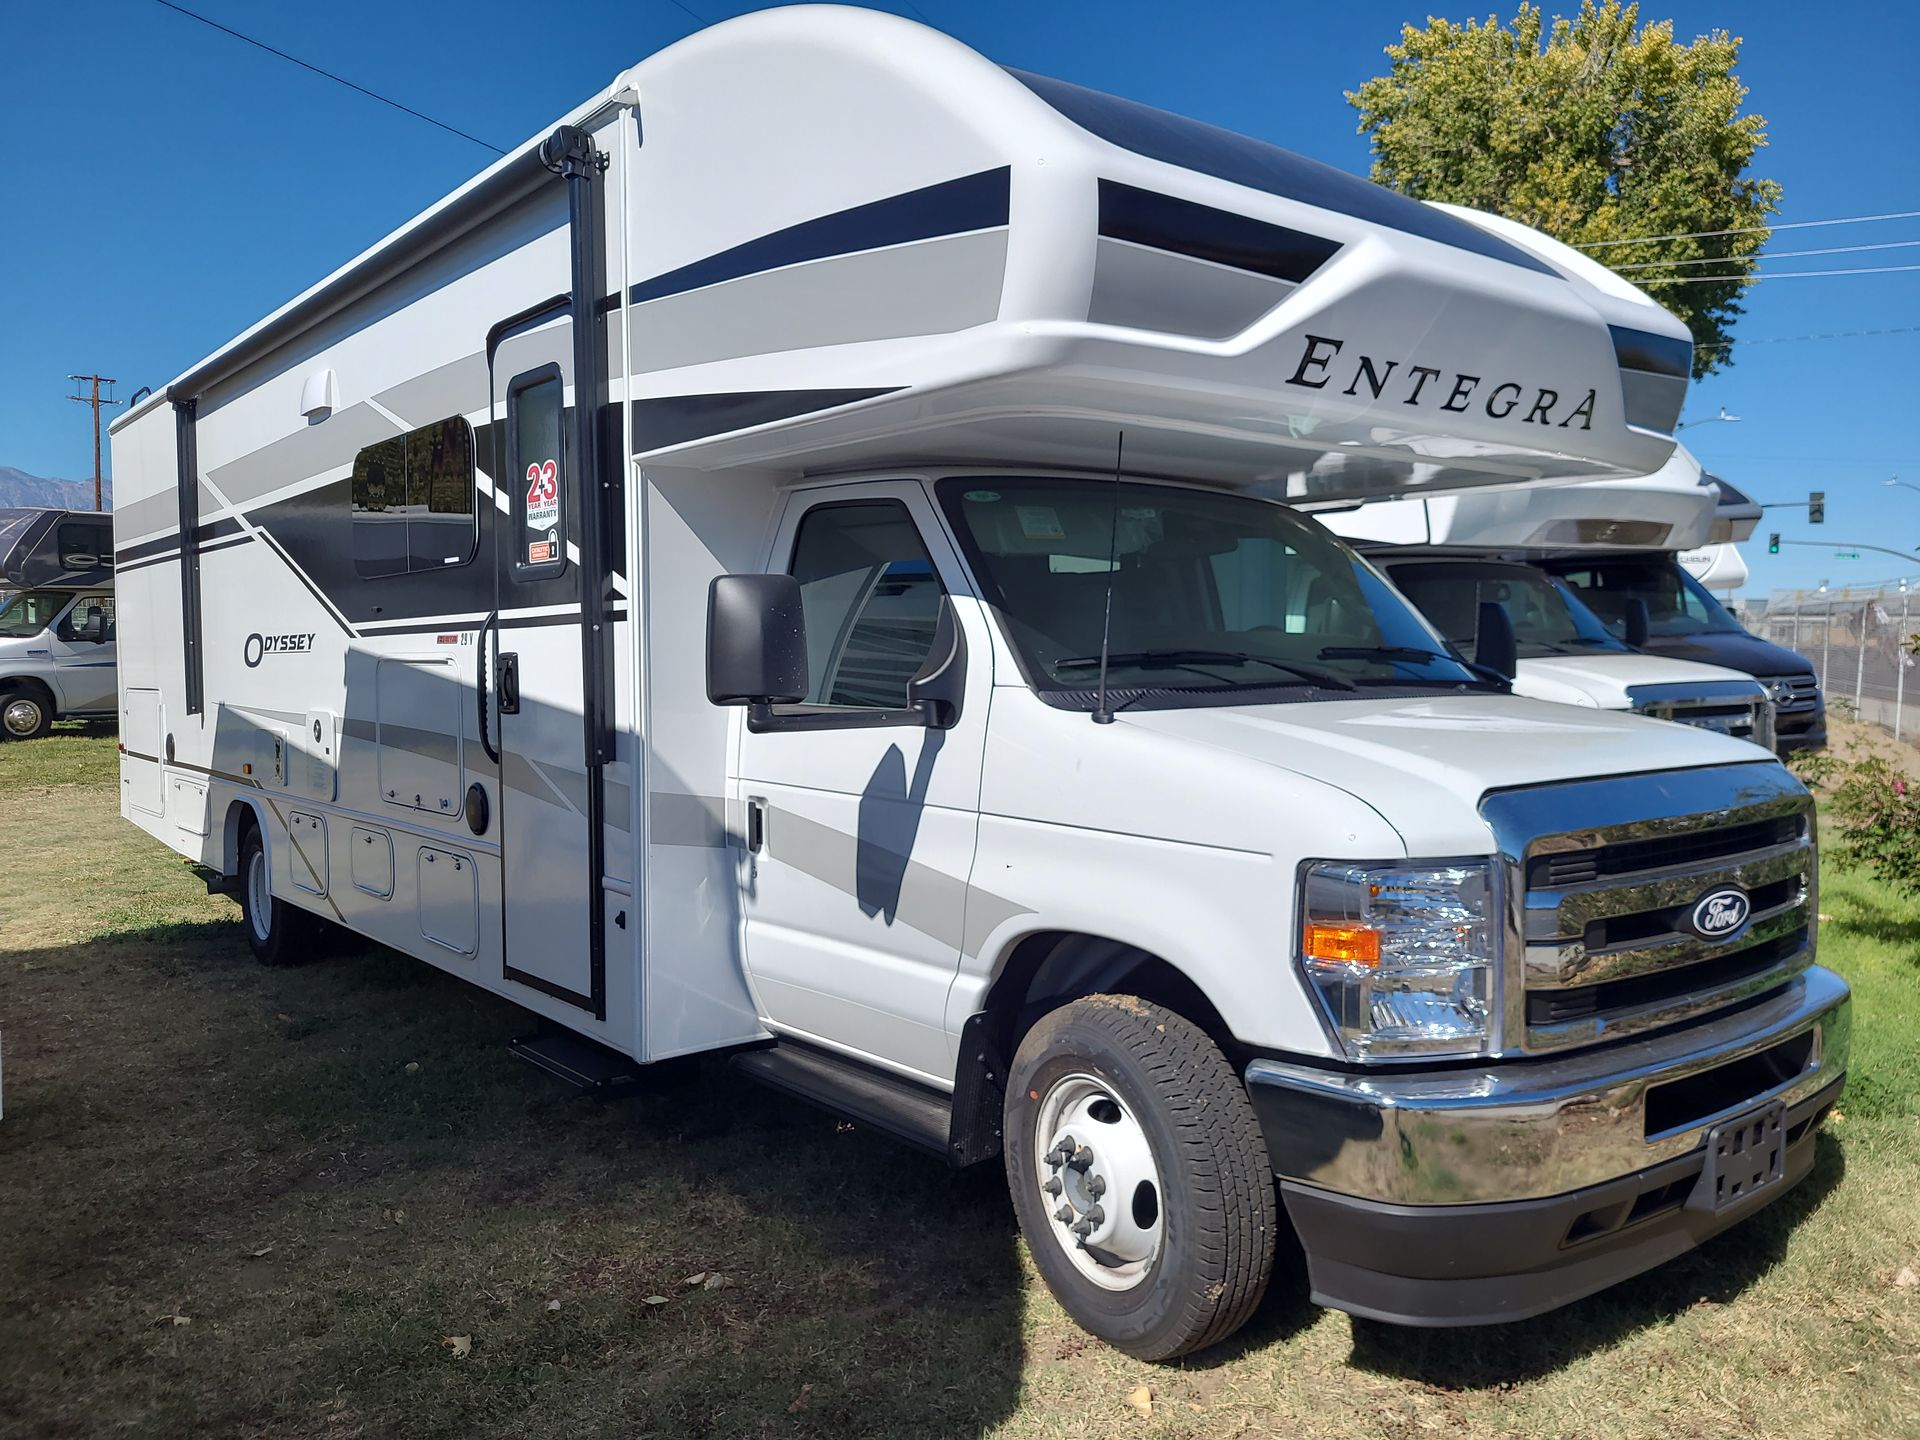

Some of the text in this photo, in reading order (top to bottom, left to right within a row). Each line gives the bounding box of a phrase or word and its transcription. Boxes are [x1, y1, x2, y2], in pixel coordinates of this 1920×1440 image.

[1284, 333, 1597, 430] ENTEGRA
[528, 499, 557, 510] YEAR YEAR
[528, 509, 557, 520] WARRANTY
[243, 632, 316, 668] ODYSSEY
[1704, 896, 1741, 930] Ford
